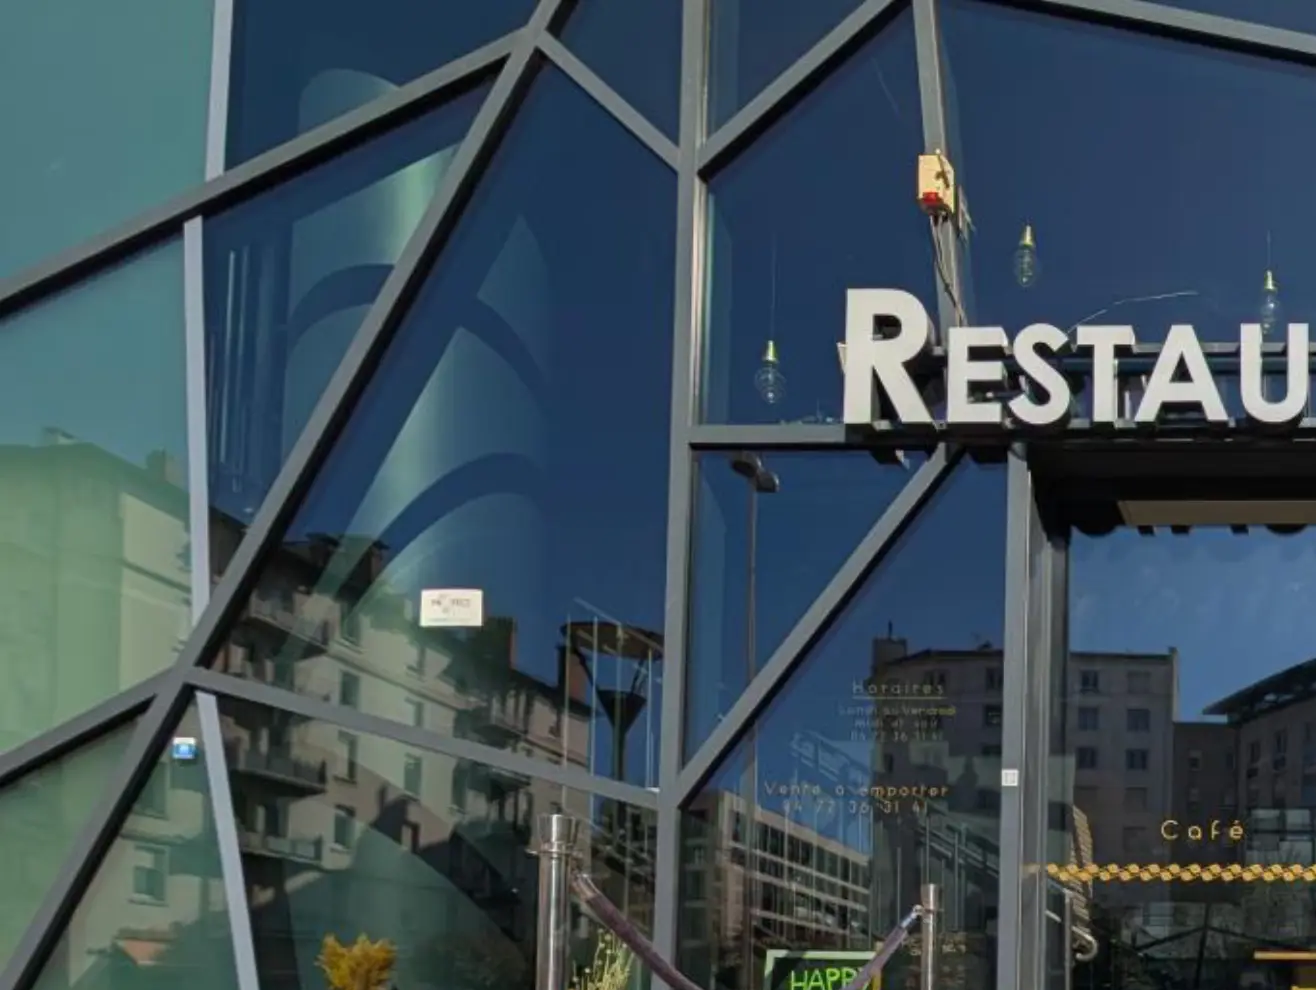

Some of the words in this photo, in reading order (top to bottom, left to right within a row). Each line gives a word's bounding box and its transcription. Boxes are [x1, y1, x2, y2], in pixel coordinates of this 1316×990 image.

[852, 679, 945, 695] Horaires
[764, 780, 821, 796] Vente
[859, 784, 949, 797] emporter
[1160, 819, 1244, 841] Café
